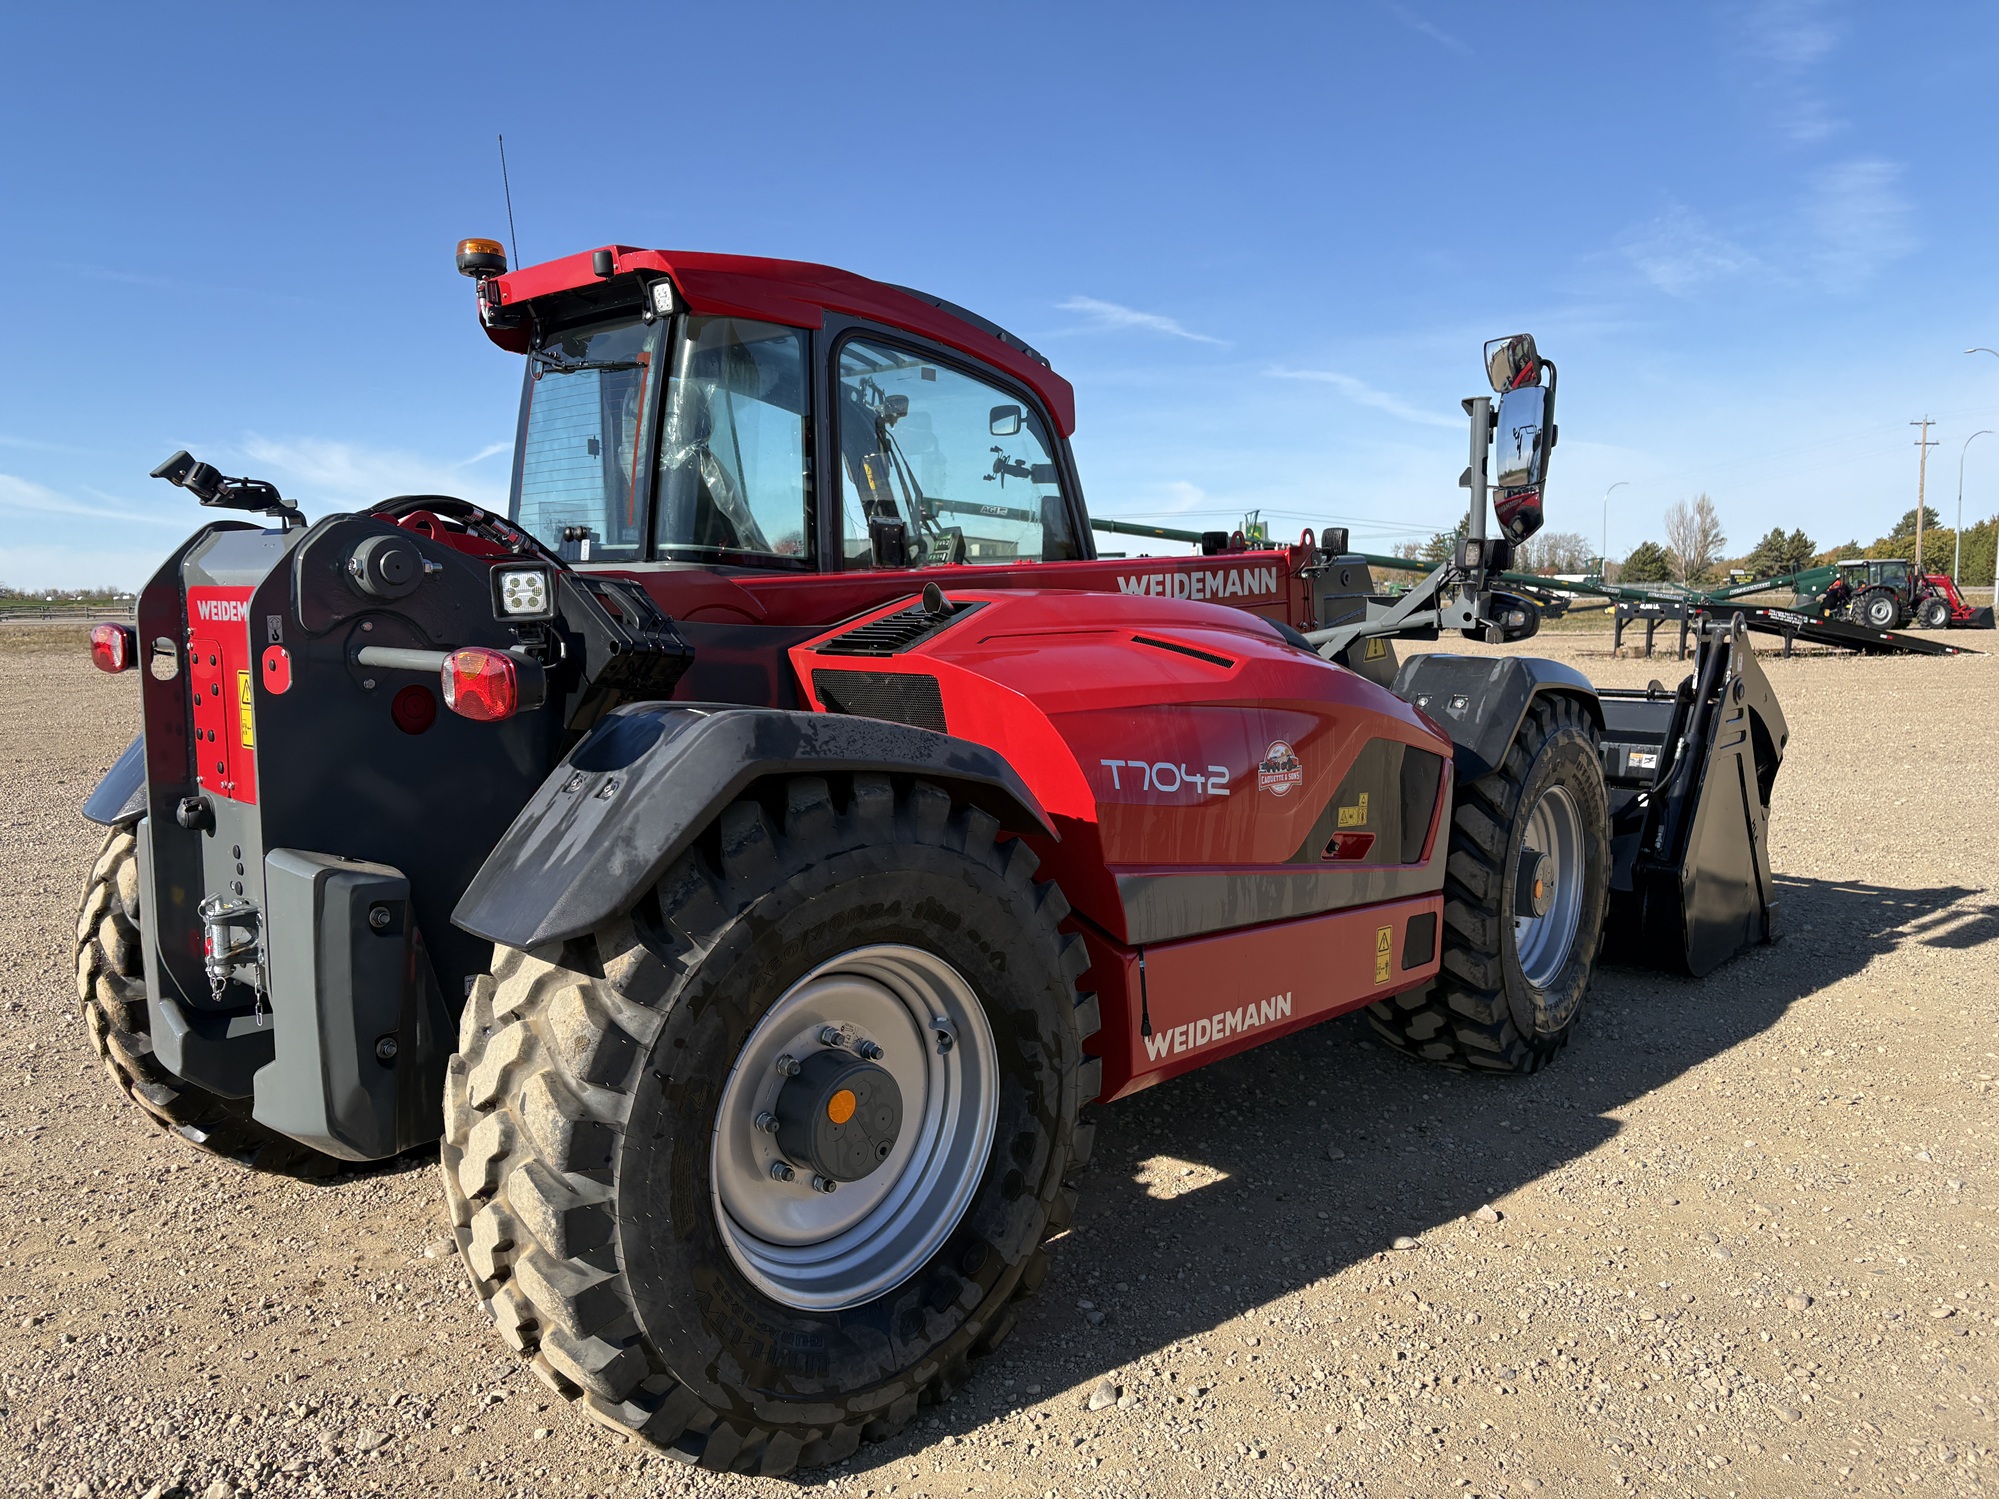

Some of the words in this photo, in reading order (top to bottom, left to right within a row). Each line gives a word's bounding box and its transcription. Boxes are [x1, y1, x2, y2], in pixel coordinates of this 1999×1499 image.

[1117, 567, 1277, 600] WEIDEMANN
[1100, 759, 1231, 796] T7042
[1288, 771, 1300, 781] SONS
[1144, 991, 1292, 1061] WEIDEMANN
